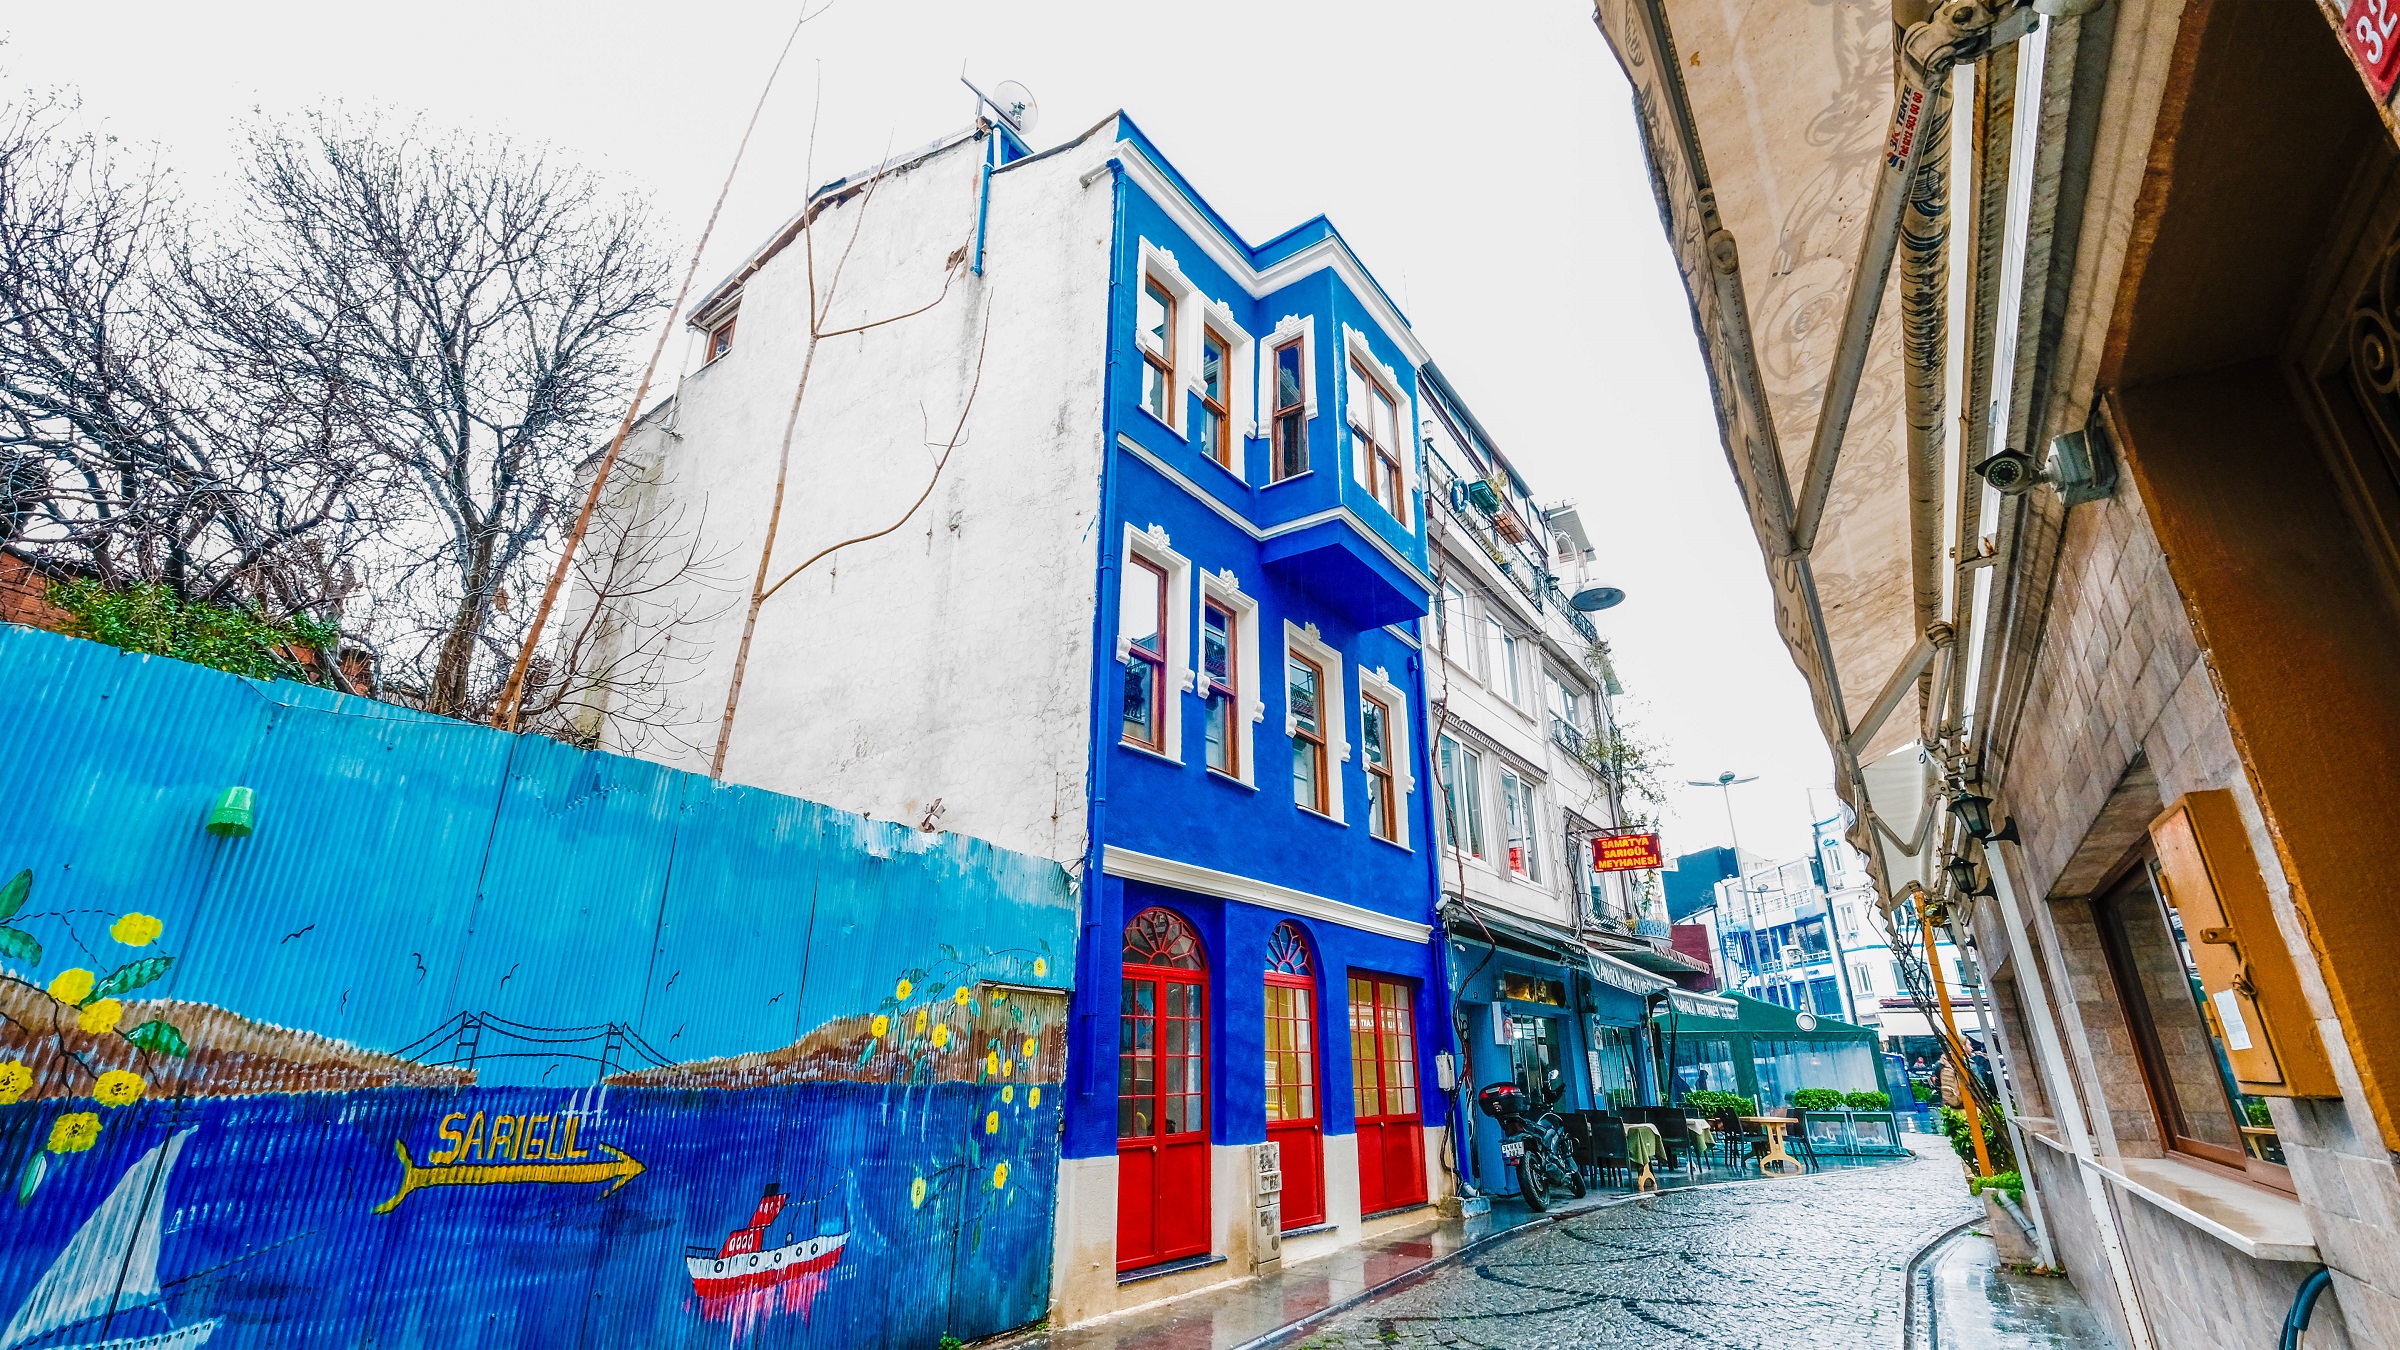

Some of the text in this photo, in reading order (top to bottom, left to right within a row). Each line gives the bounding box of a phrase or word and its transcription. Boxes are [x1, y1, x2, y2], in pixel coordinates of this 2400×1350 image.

[1913, 91, 1923, 103] 60
[1896, 84, 1912, 126] TENTE
[1910, 103, 1920, 115] 60
[1905, 115, 1917, 131] 503
[1601, 837, 1649, 849] SAMATYA
[1604, 846, 1649, 858] SARIGÜL
[1598, 854, 1658, 868] MEYHANESİ
